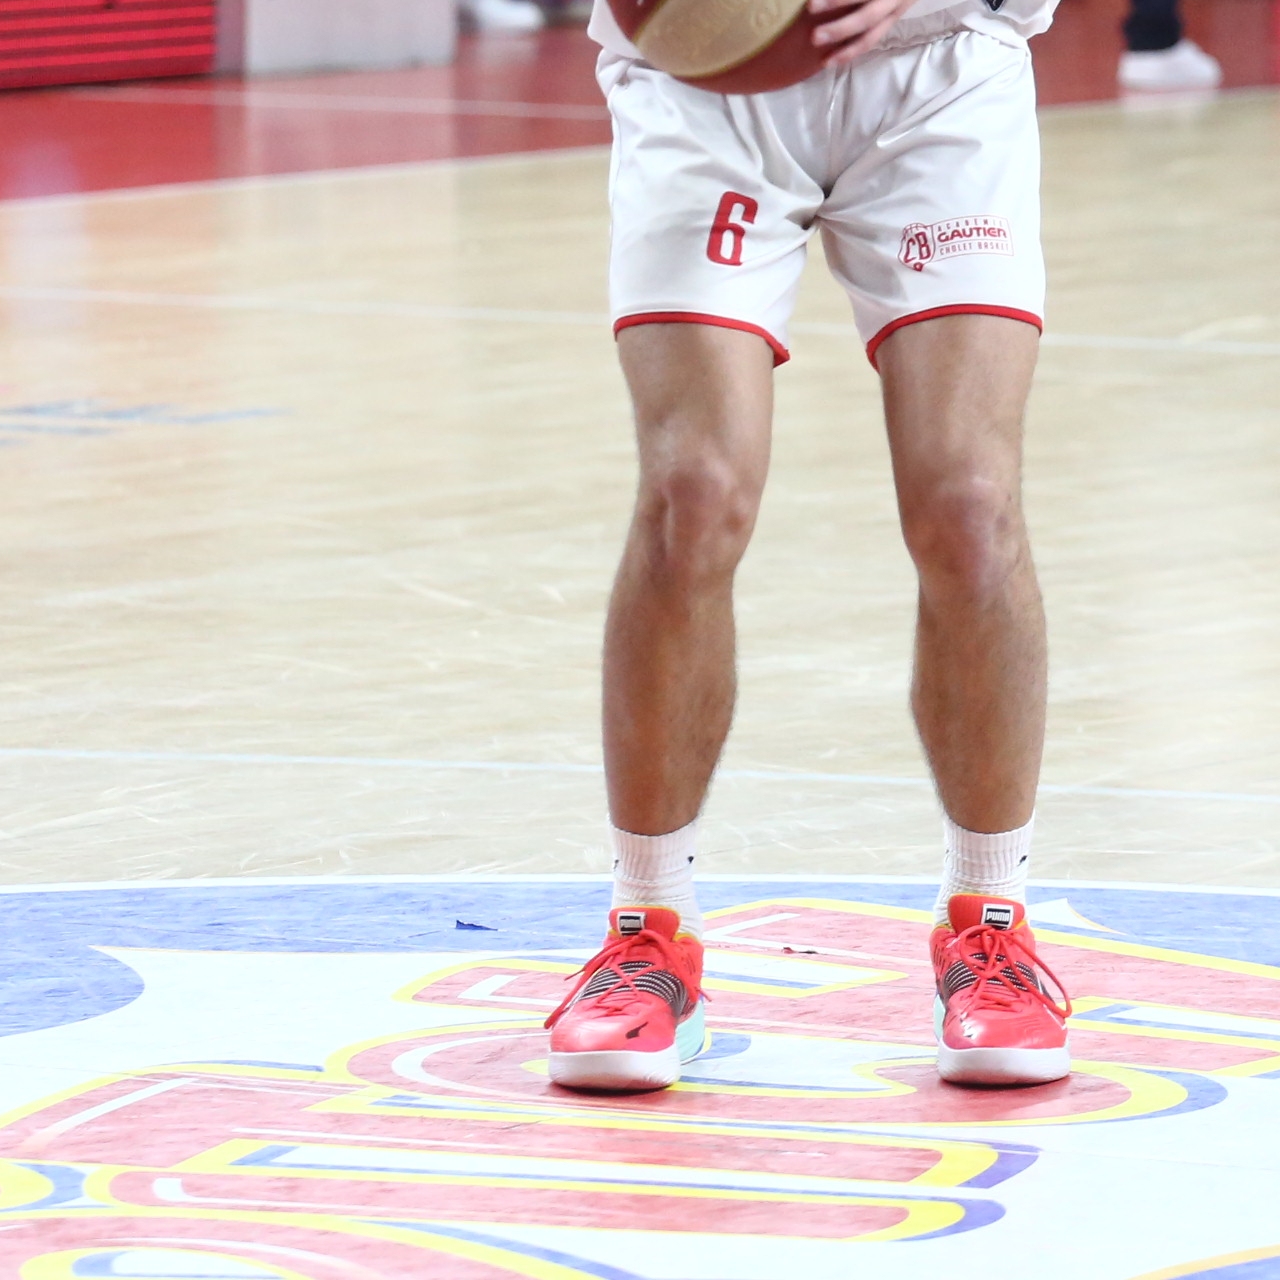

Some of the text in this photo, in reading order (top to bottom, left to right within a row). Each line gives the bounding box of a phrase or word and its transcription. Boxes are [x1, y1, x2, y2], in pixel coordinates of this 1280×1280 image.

[706, 191, 759, 266] 6
[937, 226, 1008, 243] GAUTIER
[939, 242, 973, 256] CHOLET
[986, 911, 1010, 922] PUMA
